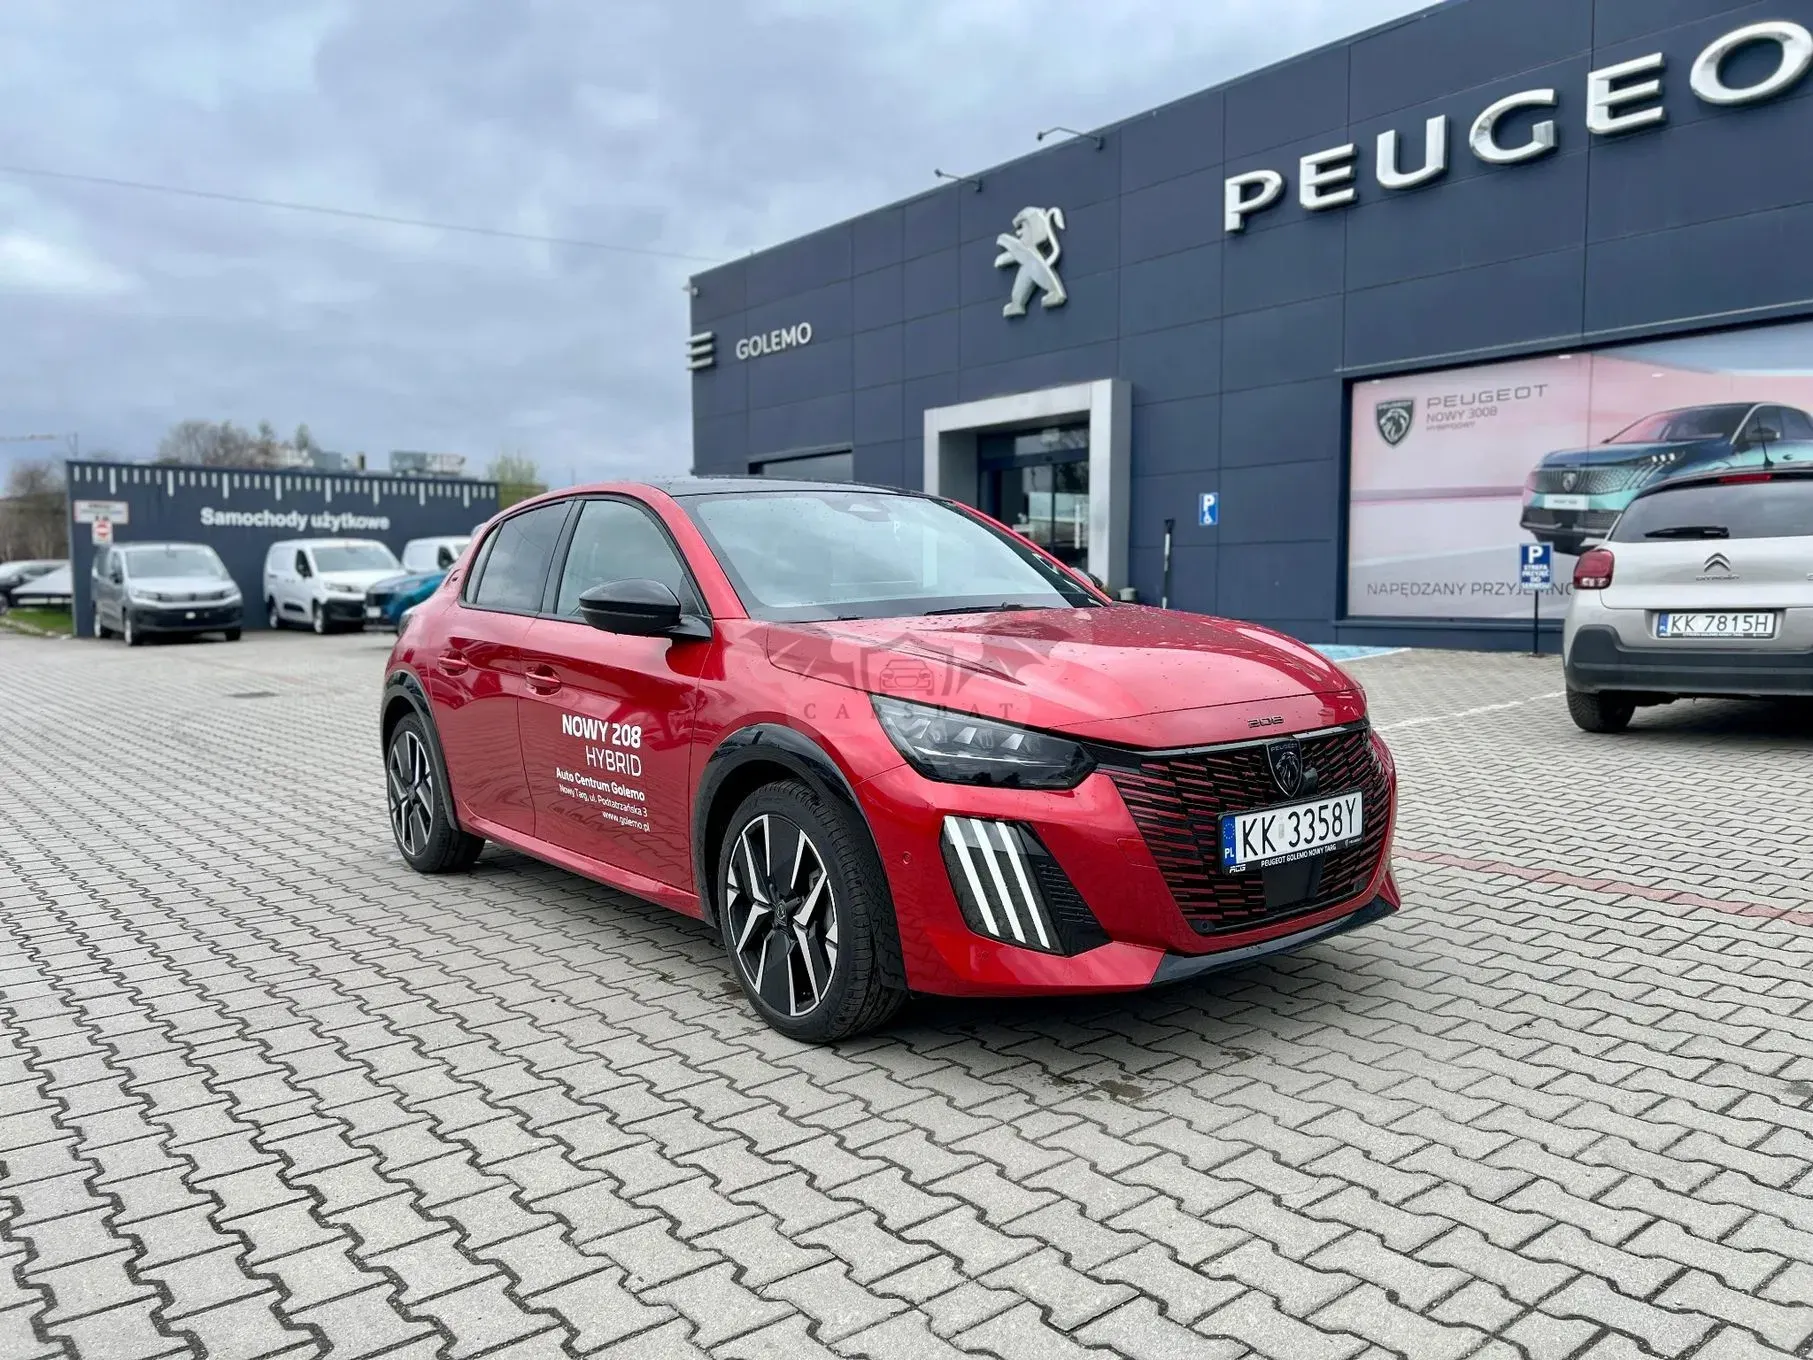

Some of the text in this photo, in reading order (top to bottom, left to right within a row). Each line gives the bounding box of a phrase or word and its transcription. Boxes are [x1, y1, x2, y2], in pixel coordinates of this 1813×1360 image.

[1224, 20, 1813, 234] PEUGEO
[736, 321, 812, 360] GOLEMO
[1426, 384, 1548, 409] PEUGEOT
[1426, 406, 1498, 423] NOWY 3008
[1203, 494, 1215, 512] P
[200, 506, 391, 533] Samochody użytkowe
[1528, 545, 1544, 564] P
[1366, 582, 1467, 599] NAPĘDZANY
[1671, 615, 1697, 632] KK
[1704, 615, 1769, 632] 7815H
[562, 714, 642, 749] NOWY 208
[585, 745, 641, 777] HYBRID
[556, 767, 645, 802] Auto Centrum Golemo
[559, 783, 575, 798] Nowy
[602, 811, 651, 832] www.golemo.pl
[1224, 797, 1357, 859] PL KK 3358Y
[1260, 856, 1287, 868] PEUGEOT
[1286, 850, 1308, 862] GOLEMO
[1308, 846, 1325, 857] NOWY
[1323, 843, 1337, 853] TARG
